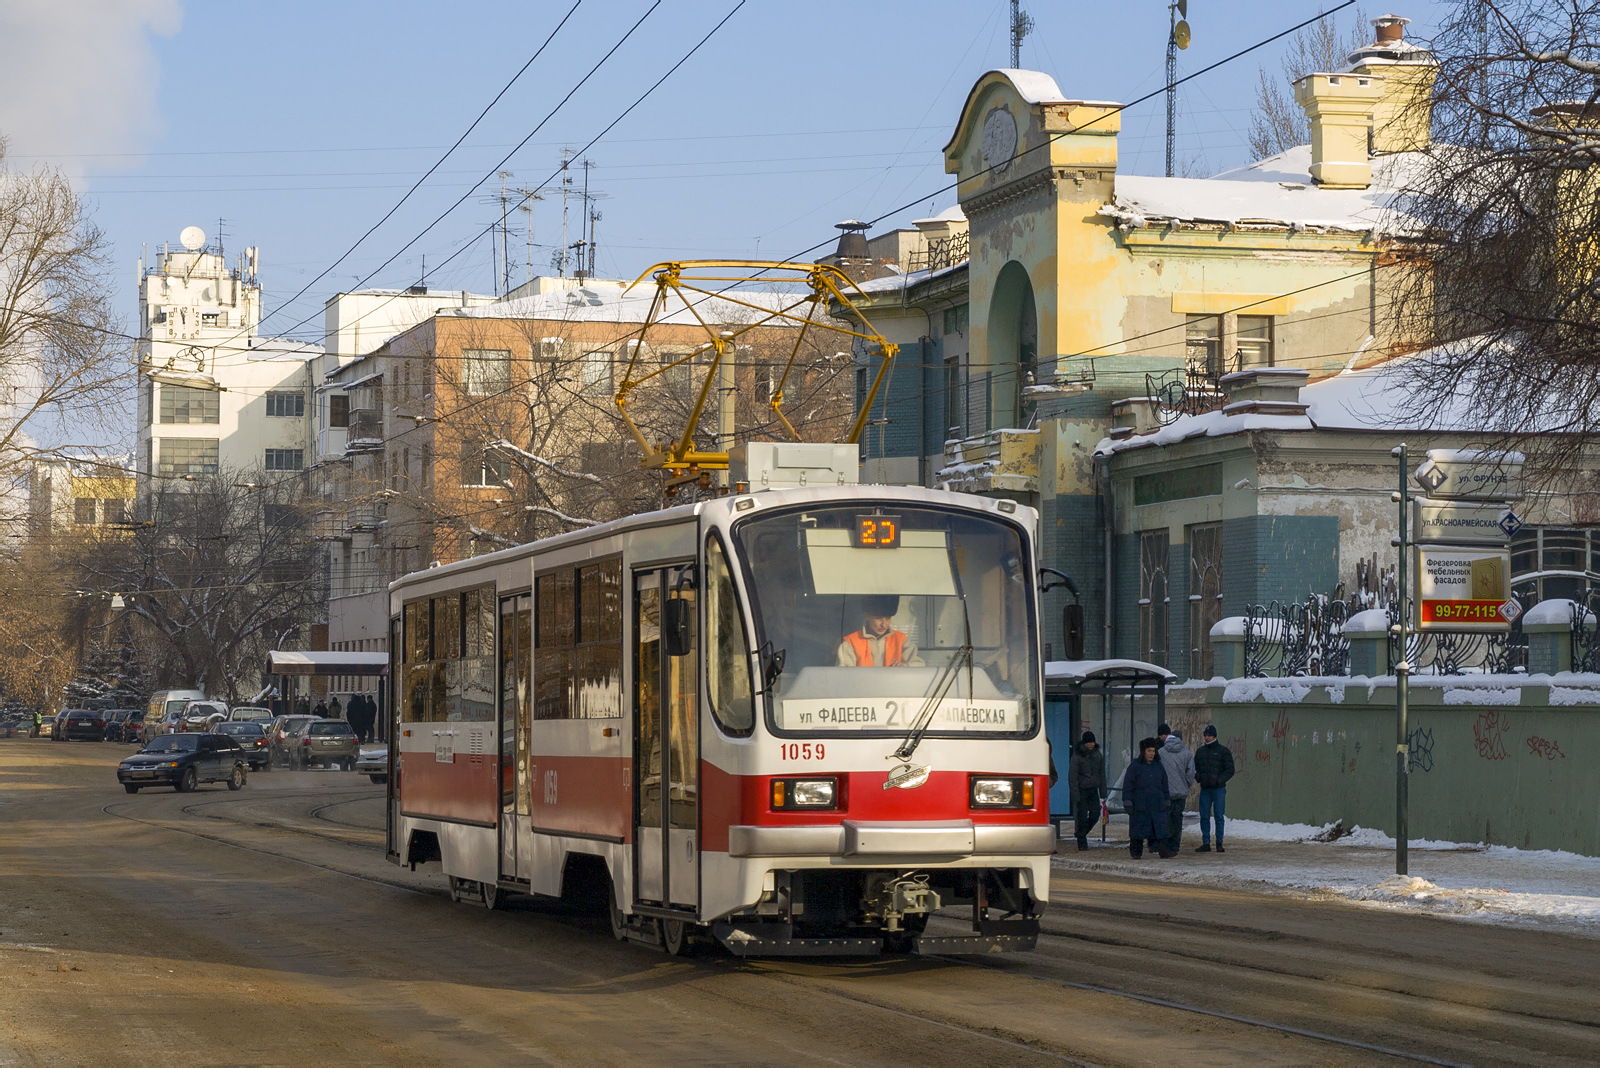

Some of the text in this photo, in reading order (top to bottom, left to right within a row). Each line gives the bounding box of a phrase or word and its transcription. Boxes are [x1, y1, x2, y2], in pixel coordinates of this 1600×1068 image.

[1458, 475, 1508, 484] ул. ФРУНЗЕ
[1426, 558, 1472, 568] Фрезеровка
[1427, 567, 1471, 576] мебельных
[1433, 575, 1467, 585] фасадов
[1435, 604, 1497, 618] 99-77-115
[818, 706, 877, 723] ФАДЕЕВА
[939, 707, 1006, 724] АПАЕВСКАЯ
[780, 743, 826, 761] 1059
[544, 769, 558, 805] 1059
